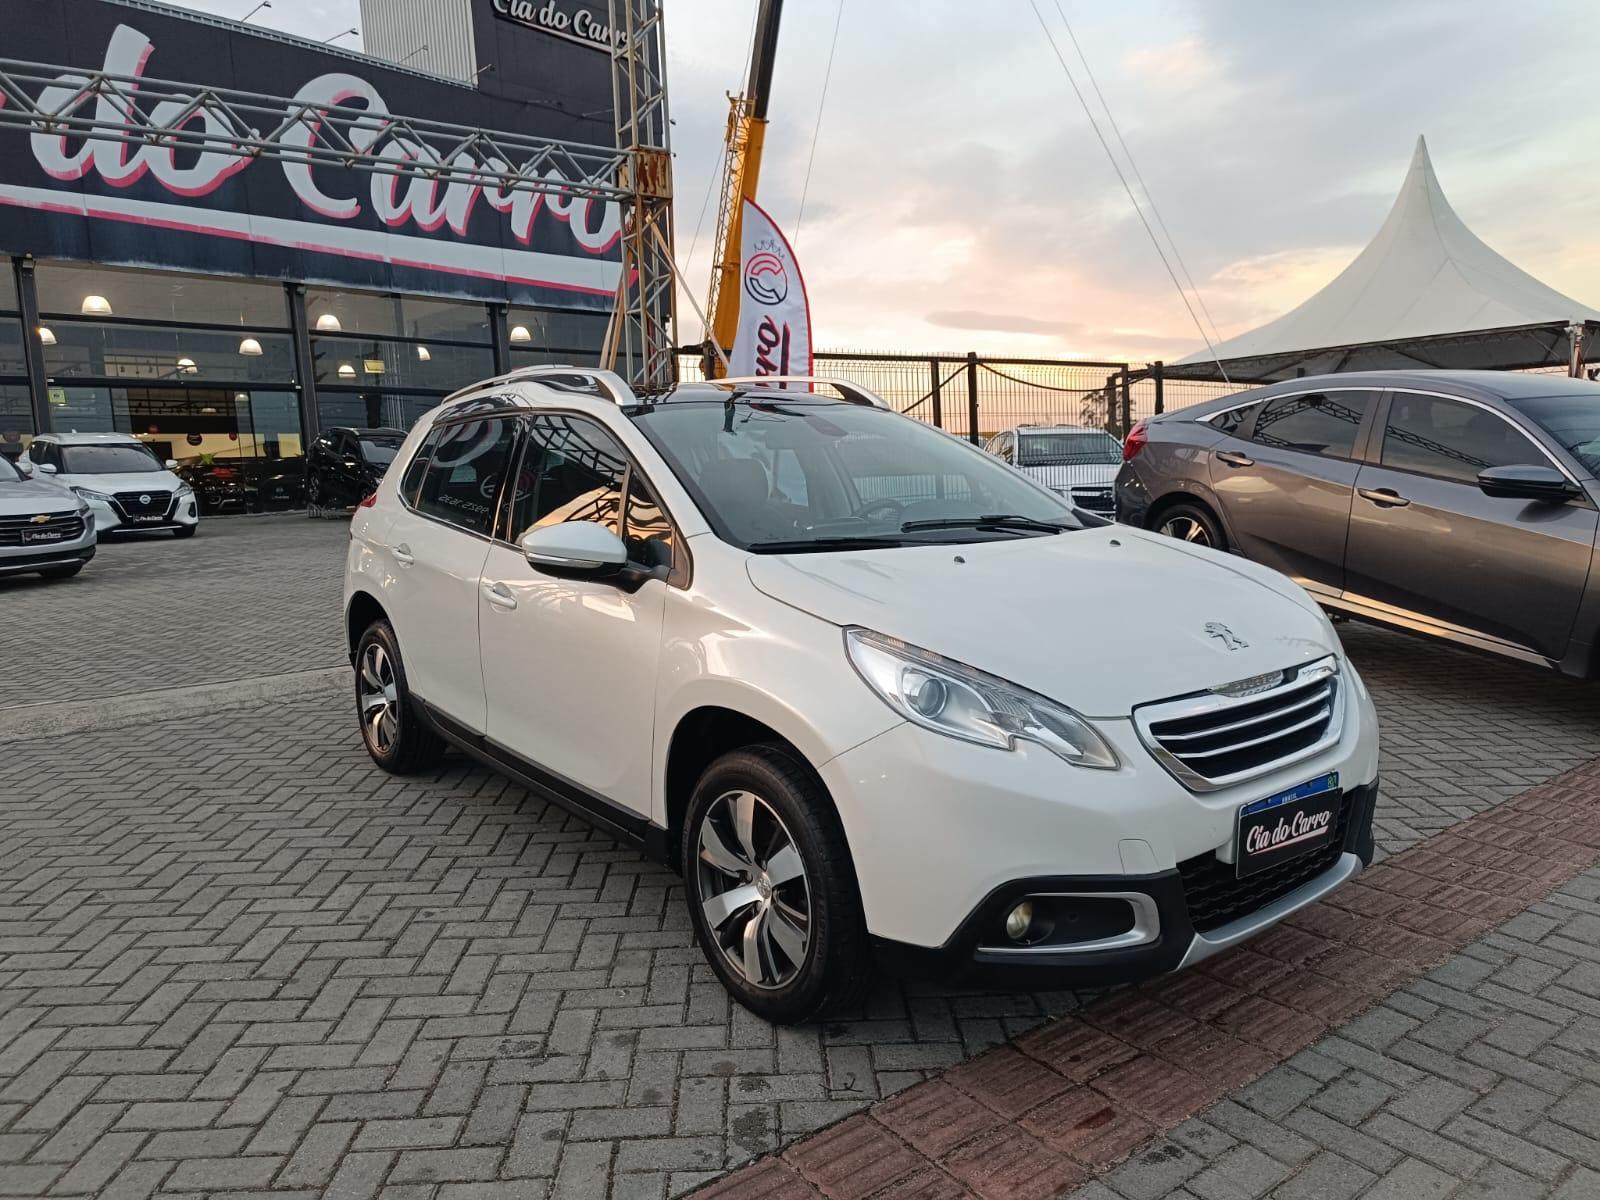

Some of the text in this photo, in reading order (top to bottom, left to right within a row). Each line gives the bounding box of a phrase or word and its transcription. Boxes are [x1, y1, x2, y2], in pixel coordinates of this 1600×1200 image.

[539, 1, 571, 29] do
[574, 10, 638, 46] Carr
[30, 23, 634, 254] do Carro
[1246, 810, 1332, 852] Cia do Carro
